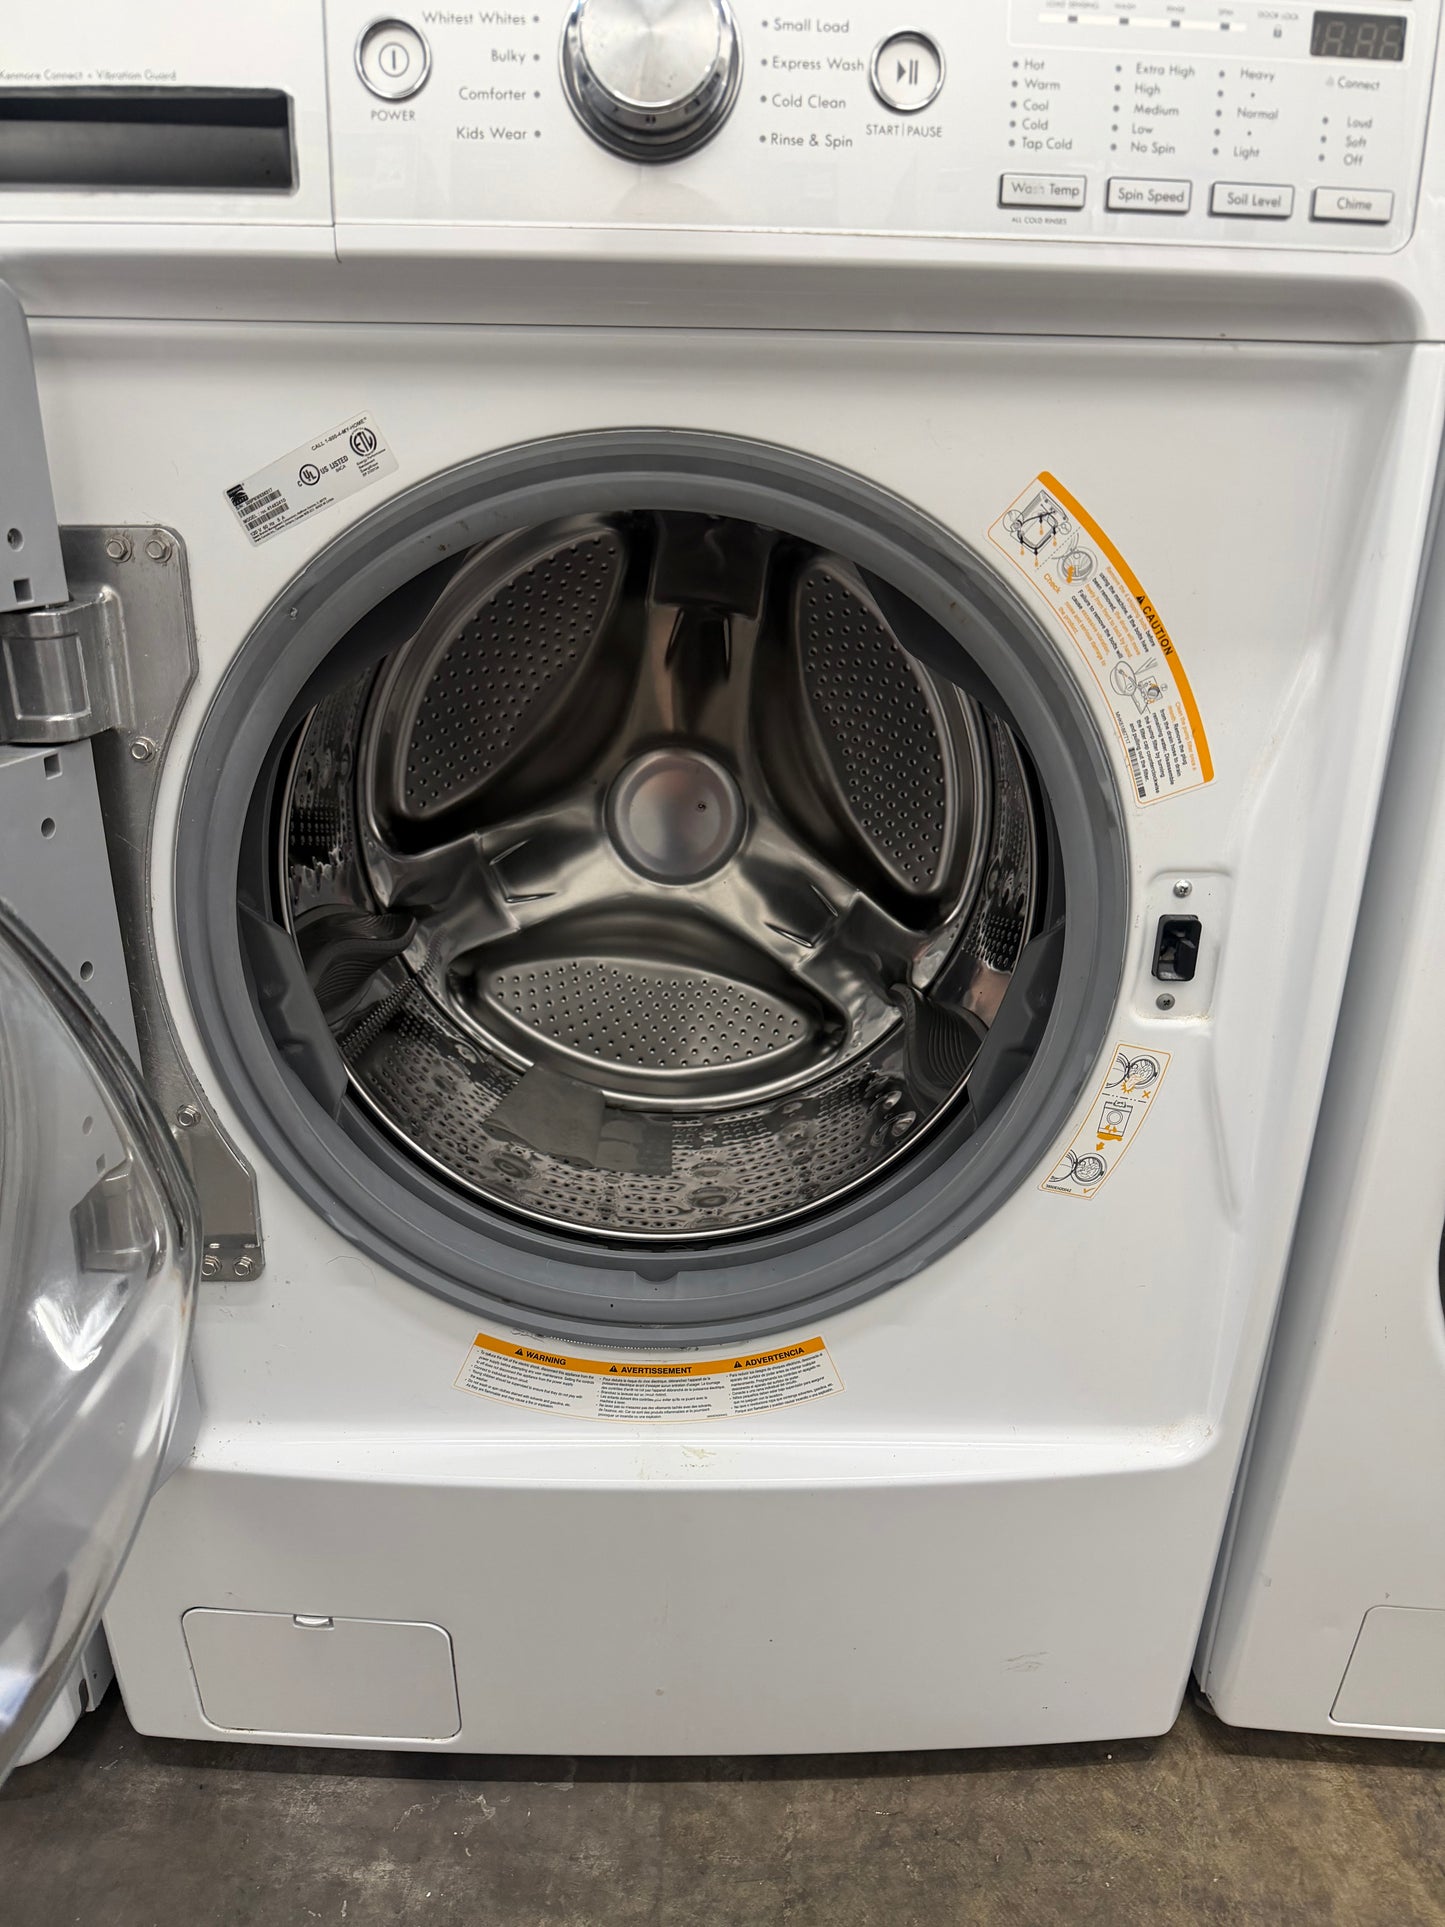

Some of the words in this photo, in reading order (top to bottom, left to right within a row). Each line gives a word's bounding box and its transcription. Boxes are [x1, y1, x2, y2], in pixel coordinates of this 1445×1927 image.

[422, 12, 473, 24] Whitest
[480, 12, 526, 25] Whites
[774, 18, 811, 32] Small
[817, 19, 850, 33] Load
[491, 50, 526, 64] Bulky
[772, 56, 821, 71] Express
[827, 58, 864, 71] Wash
[1024, 59, 1045, 70] Hot
[1136, 63, 1165, 76] Extra
[1169, 64, 1195, 79] High
[1241, 69, 1275, 82] Heavy
[1025, 78, 1060, 90] Warm
[1134, 83, 1160, 97] High
[1338, 77, 1380, 90] Connect
[458, 86, 526, 101] Comforter
[772, 94, 802, 108] Cold
[808, 95, 846, 109] Clean
[1023, 99, 1049, 111] Cool
[371, 110, 416, 122] POWER
[1133, 104, 1179, 116] Medium
[1237, 108, 1278, 120] Normal
[1022, 118, 1048, 131] Cold
[1132, 123, 1153, 134] Low
[1347, 118, 1373, 129] Loud
[456, 127, 485, 140] Kids
[490, 127, 527, 140] Wear
[771, 133, 805, 146] Rinse
[809, 135, 819, 147] &
[825, 135, 853, 150] Spin
[1022, 137, 1043, 151] Tap
[1046, 138, 1072, 150] Cold
[1346, 136, 1366, 148] Soft
[1131, 142, 1148, 153] No
[1152, 143, 1175, 156] Spin
[1233, 147, 1259, 160] Light
[1343, 154, 1363, 166] Off
[1050, 183, 1080, 199] Temp
[1118, 188, 1143, 201] Spin
[1147, 189, 1184, 203] Speed
[1227, 193, 1248, 205] Soil
[1252, 195, 1281, 207] Level
[1337, 197, 1372, 210] Chime
[319, 465, 329, 474] US
[329, 455, 348, 469] LISTED
[1043, 572, 1062, 594] Check
[1078, 589, 1090, 606] Failure
[1142, 606, 1172, 655] CAUTION
[1173, 723, 1181, 743] Remove
[526, 1351, 567, 1366] WARNING
[620, 1366, 693, 1375] AVERTISSEMENT
[745, 1347, 805, 1367] ADVERTENCIA
